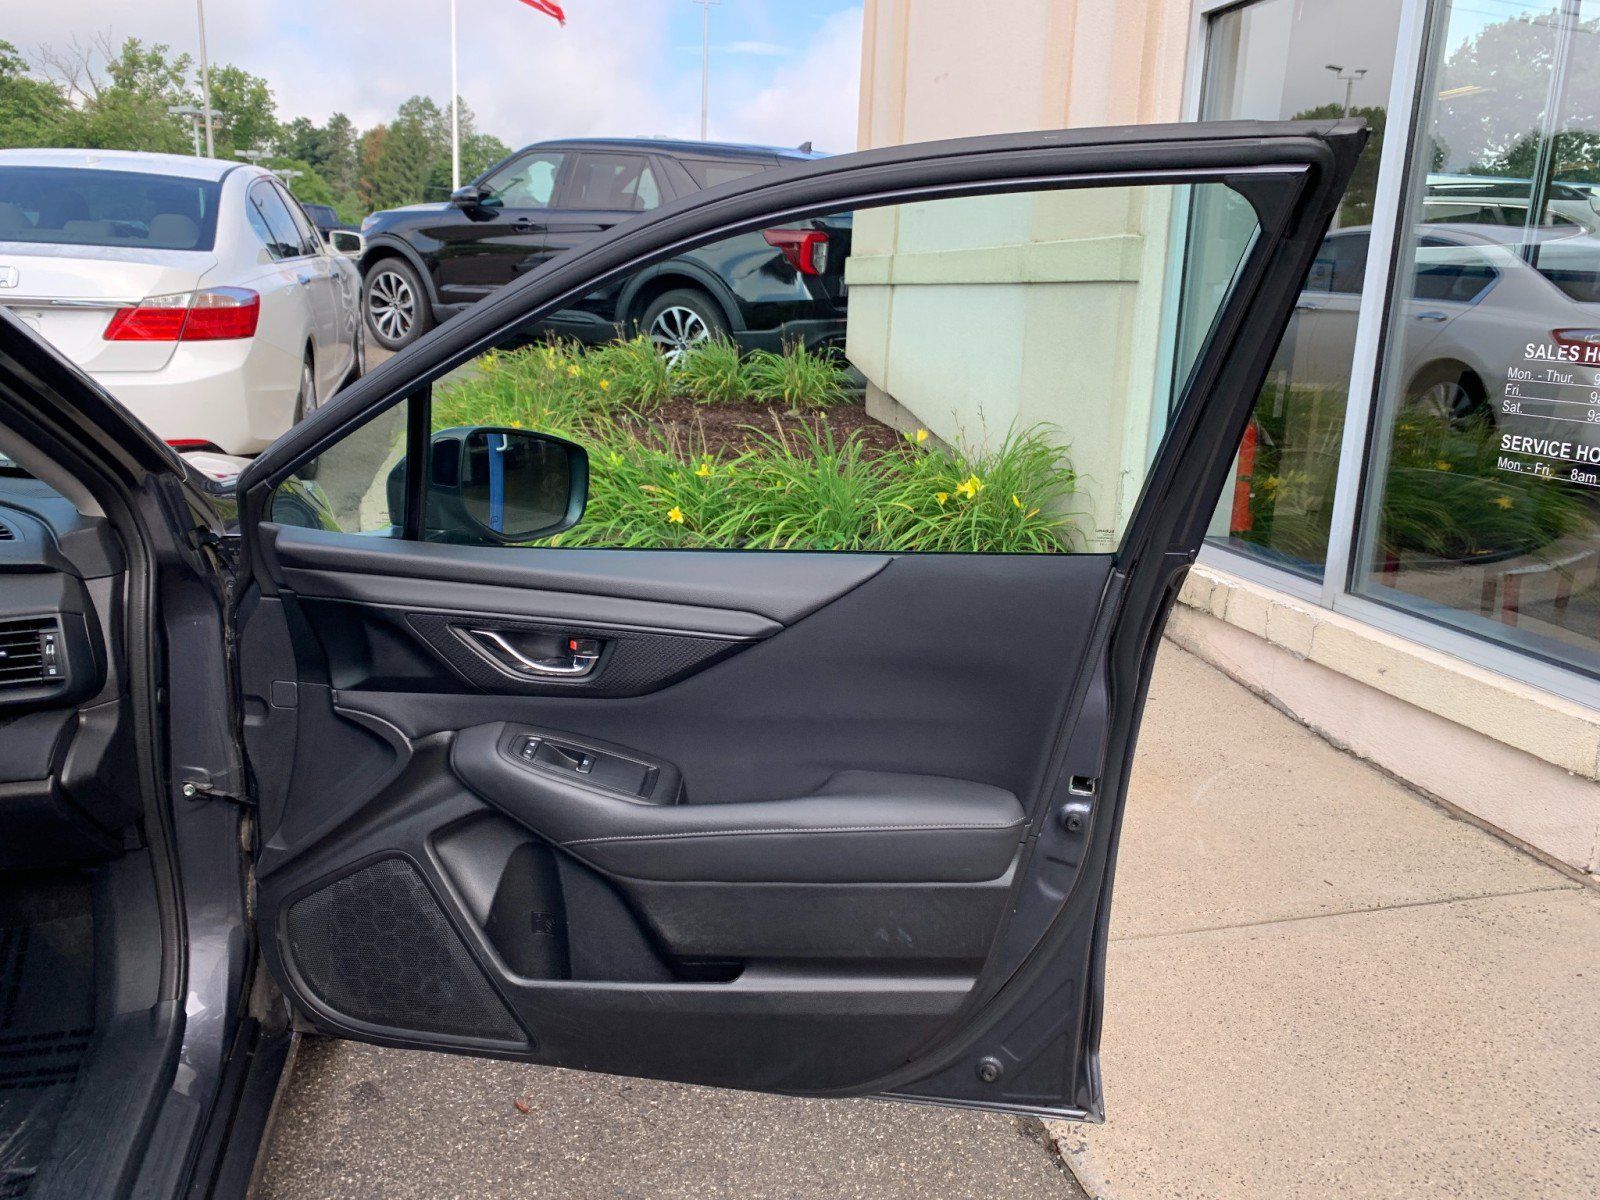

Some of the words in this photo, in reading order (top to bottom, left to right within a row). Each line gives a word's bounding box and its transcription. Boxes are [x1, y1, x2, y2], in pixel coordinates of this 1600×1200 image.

[1525, 343, 1580, 362] SALES
[1585, 346, 1600, 363] H
[1507, 367, 1534, 380] Mon.
[1546, 370, 1574, 384] Thur.
[1505, 383, 1522, 396] Fri.
[1502, 400, 1522, 413] Sat.
[1501, 434, 1572, 459] SERVICE
[1497, 456, 1524, 471] Mon.
[1535, 462, 1552, 477] Fri.
[1570, 468, 1597, 484] 8am
